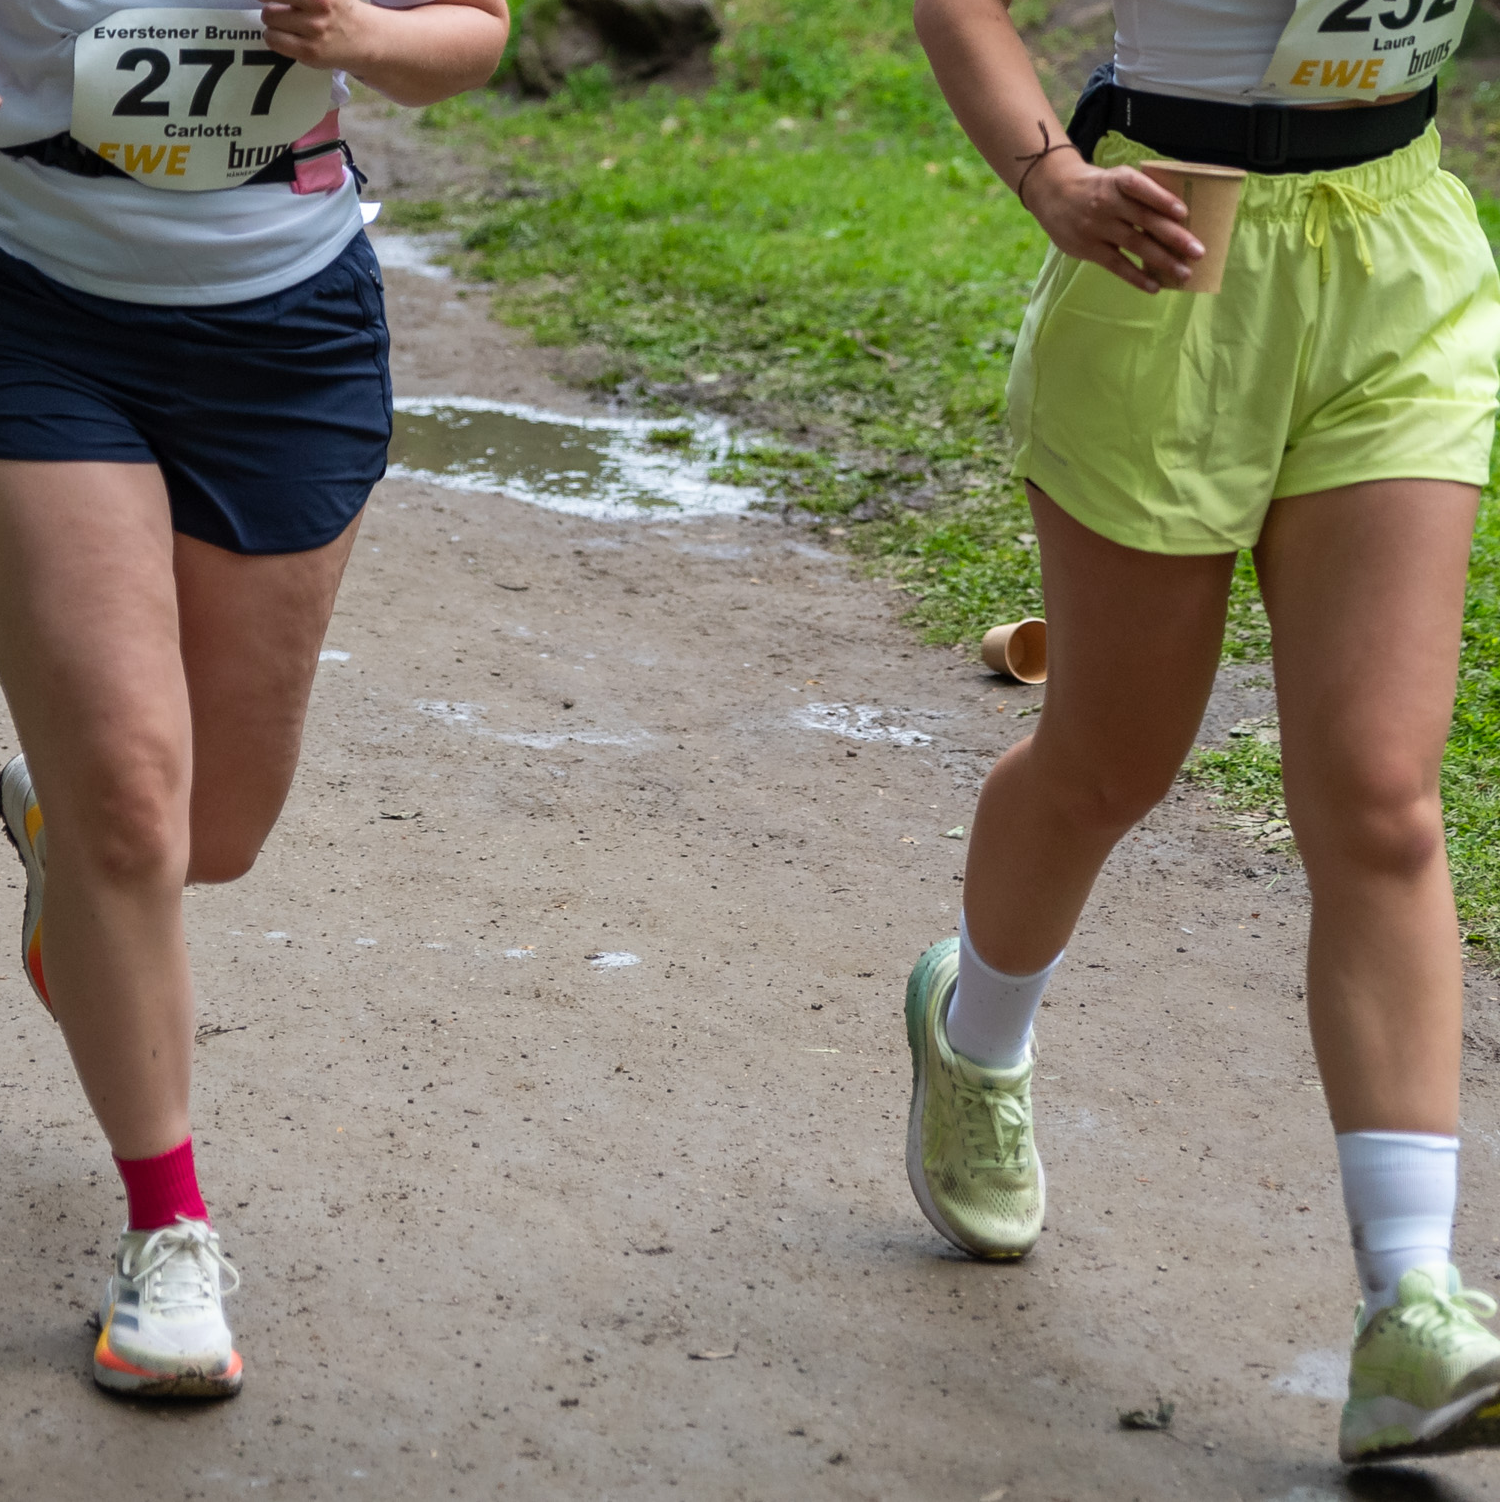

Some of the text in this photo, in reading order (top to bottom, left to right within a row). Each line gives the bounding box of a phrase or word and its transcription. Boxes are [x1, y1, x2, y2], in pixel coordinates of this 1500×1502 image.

[93, 26, 265, 40] Everstener Brunn
[1372, 35, 1416, 52] Laura
[1407, 39, 1453, 77] bruns
[111, 47, 298, 117] 277
[1289, 58, 1385, 90] EWE
[163, 124, 243, 138] Carlotta
[98, 142, 191, 177] EWE
[228, 141, 288, 170] brun
